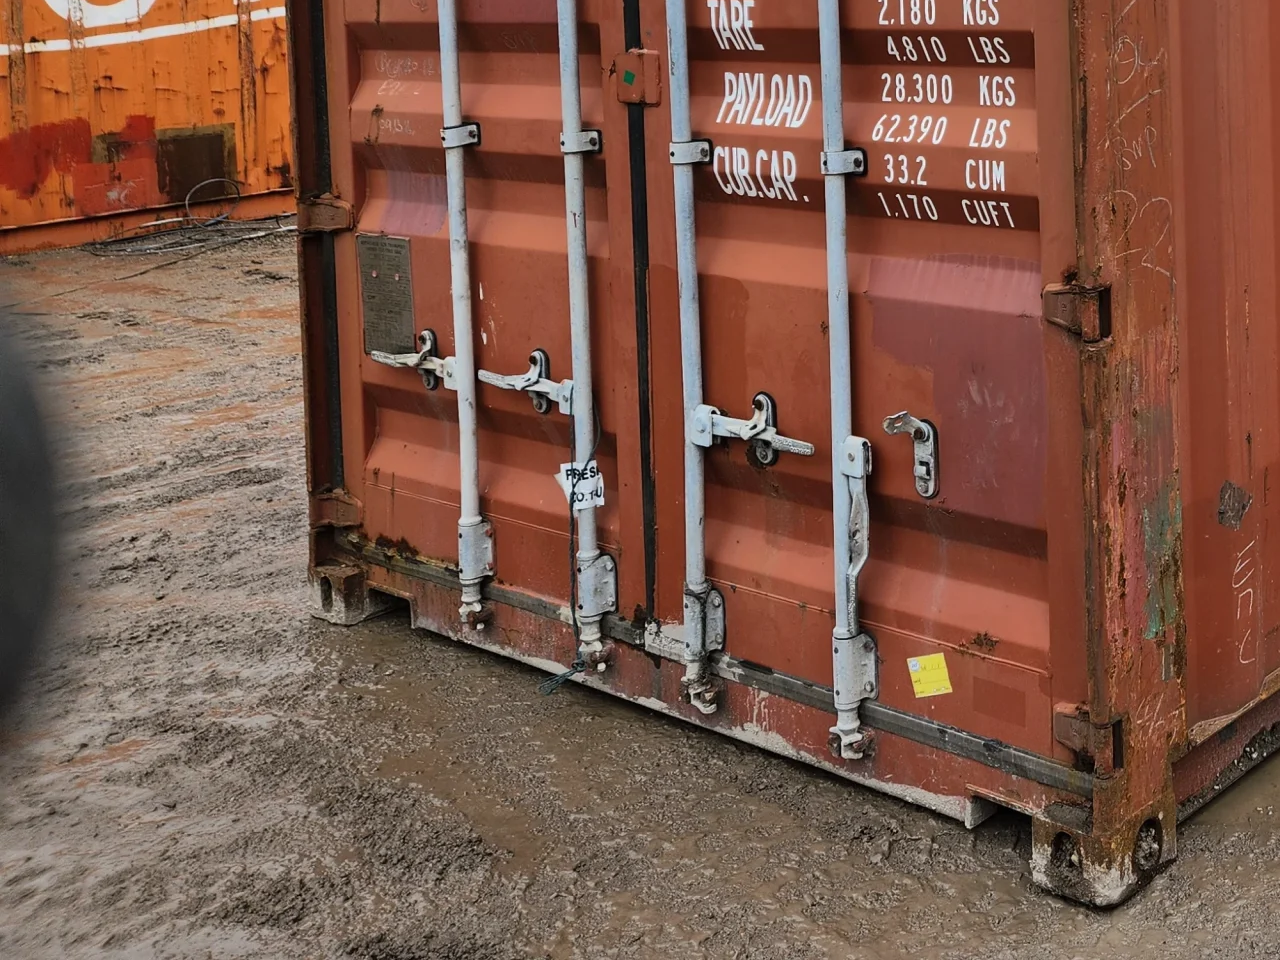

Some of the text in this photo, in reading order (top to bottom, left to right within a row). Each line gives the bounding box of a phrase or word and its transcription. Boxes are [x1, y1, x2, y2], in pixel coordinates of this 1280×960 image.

[706, 0, 766, 52] TARE
[967, 36, 1011, 65] LBS
[714, 71, 1017, 129] PAYLOAD 28,300 KGS
[871, 114, 1011, 150] 62,390 LBS
[883, 153, 928, 186] 33.2
[964, 159, 1006, 193] CUM
[960, 199, 1016, 229] CUFT
